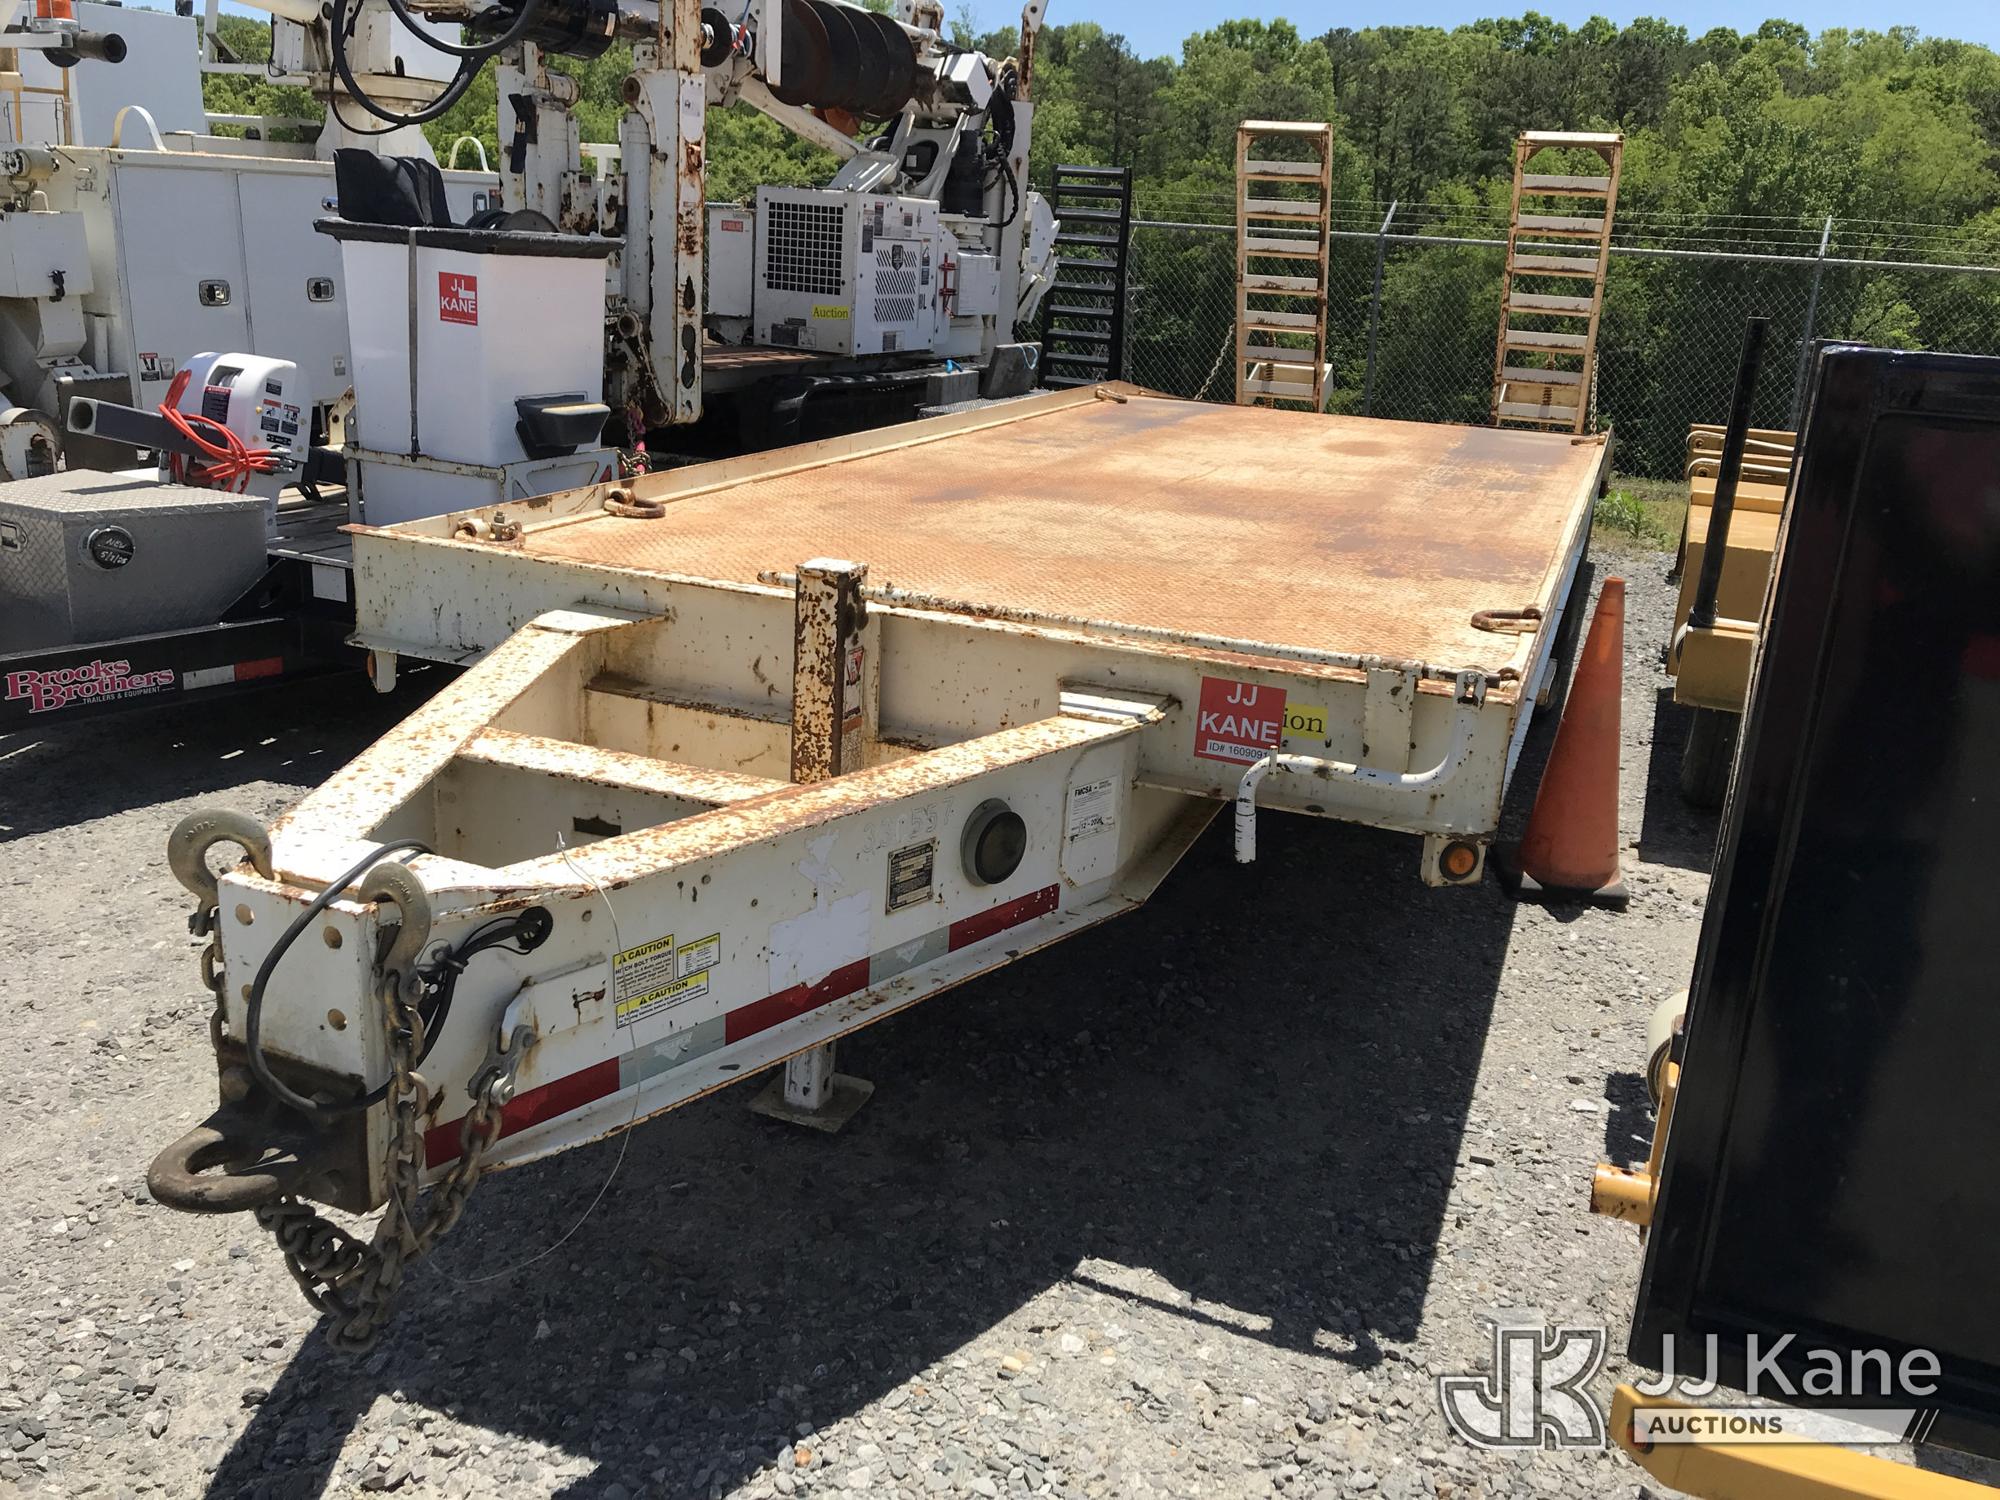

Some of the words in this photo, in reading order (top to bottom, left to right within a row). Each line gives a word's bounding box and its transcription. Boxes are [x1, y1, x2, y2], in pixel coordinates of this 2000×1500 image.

[441, 296, 477, 314] KANE
[813, 307, 848, 319] Auction
[5, 659, 131, 700] Brooks
[29, 669, 174, 714] Brothers
[83, 693, 116, 705] TRAILERS
[124, 686, 161, 698] EQUIPMENT
[1227, 684, 1258, 707] JJ
[1200, 711, 1279, 744] KANE
[1209, 743, 1225, 753] ID#
[1075, 785, 1092, 797] FMCSA
[628, 939, 670, 960] CAUTION
[634, 957, 649, 968] BOLT
[650, 950, 672, 963] TORQUE
[648, 981, 688, 1001] CAUTION
